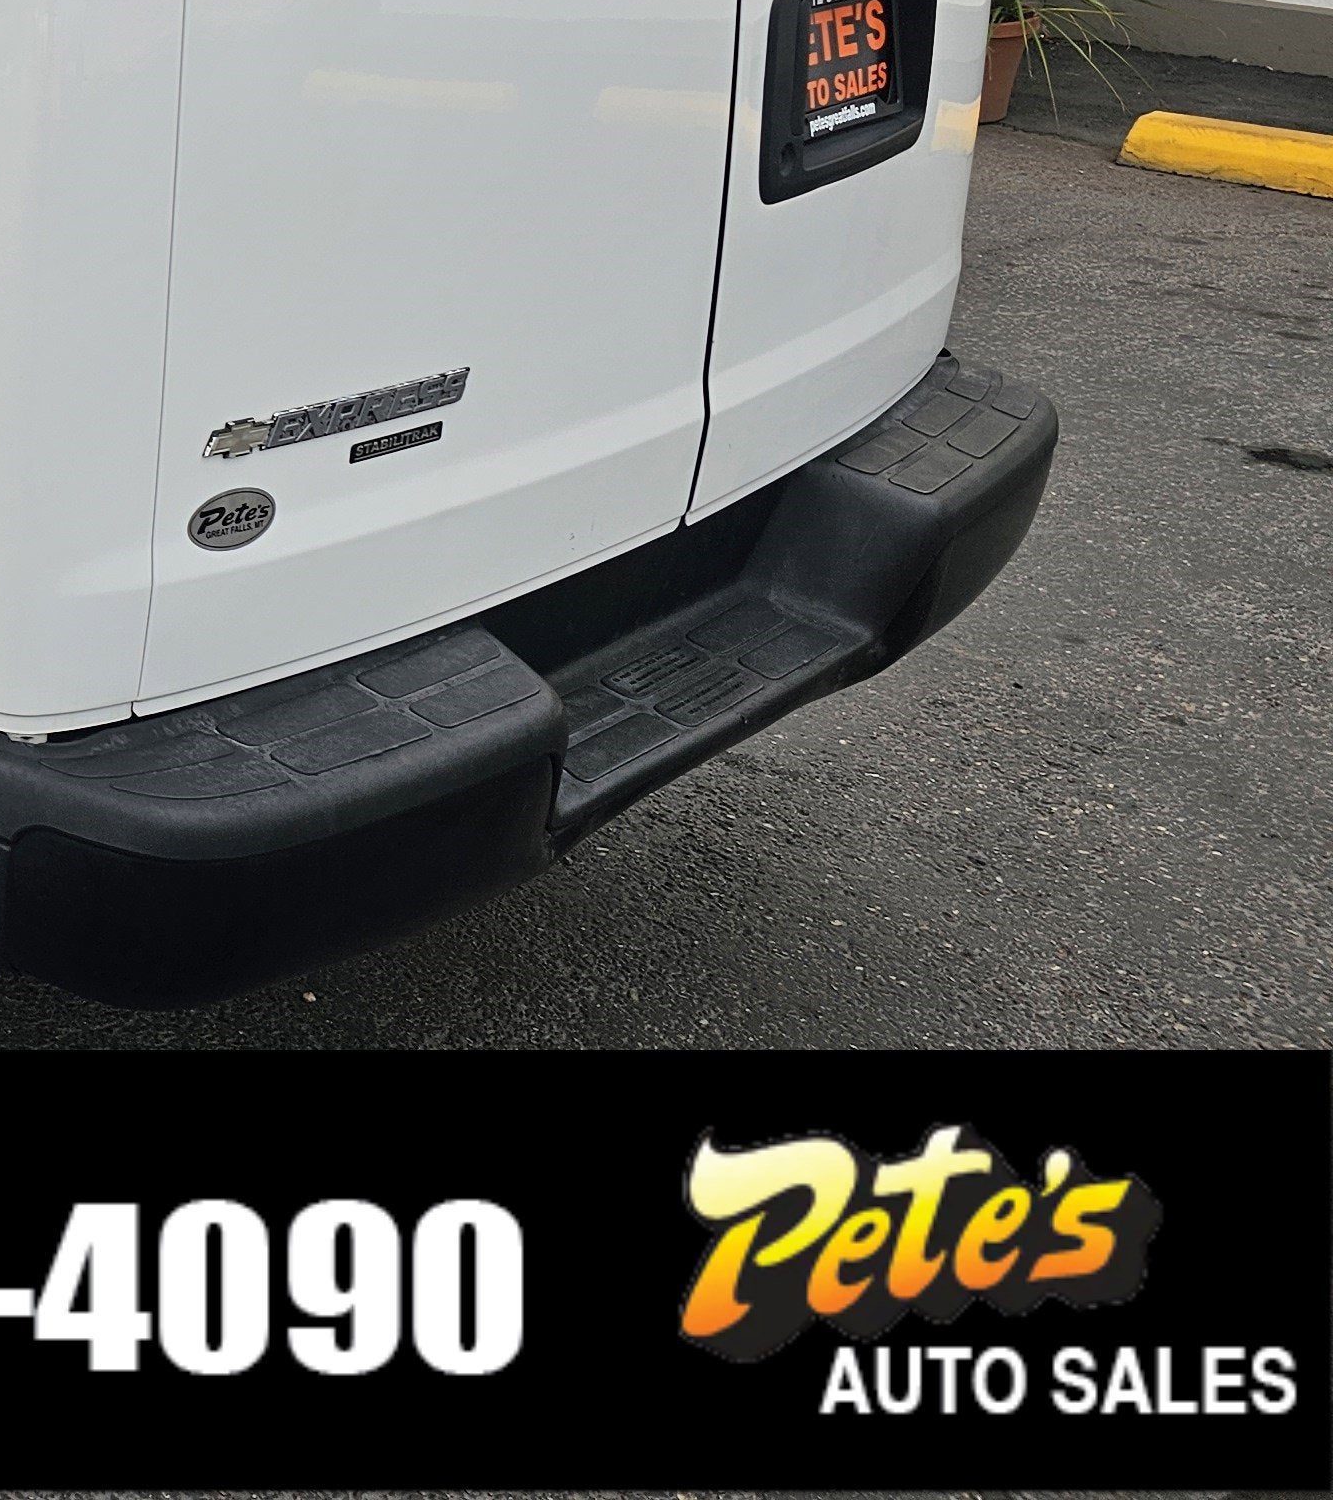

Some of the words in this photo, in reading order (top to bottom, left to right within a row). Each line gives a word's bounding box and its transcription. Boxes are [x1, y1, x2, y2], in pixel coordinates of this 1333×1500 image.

[806, 78, 830, 110] TO
[834, 61, 887, 101] SALES
[266, 369, 468, 448] EXPRESS
[355, 425, 440, 458] STABILITRAK
[197, 502, 270, 535] Pete's
[205, 527, 229, 539] GREAT
